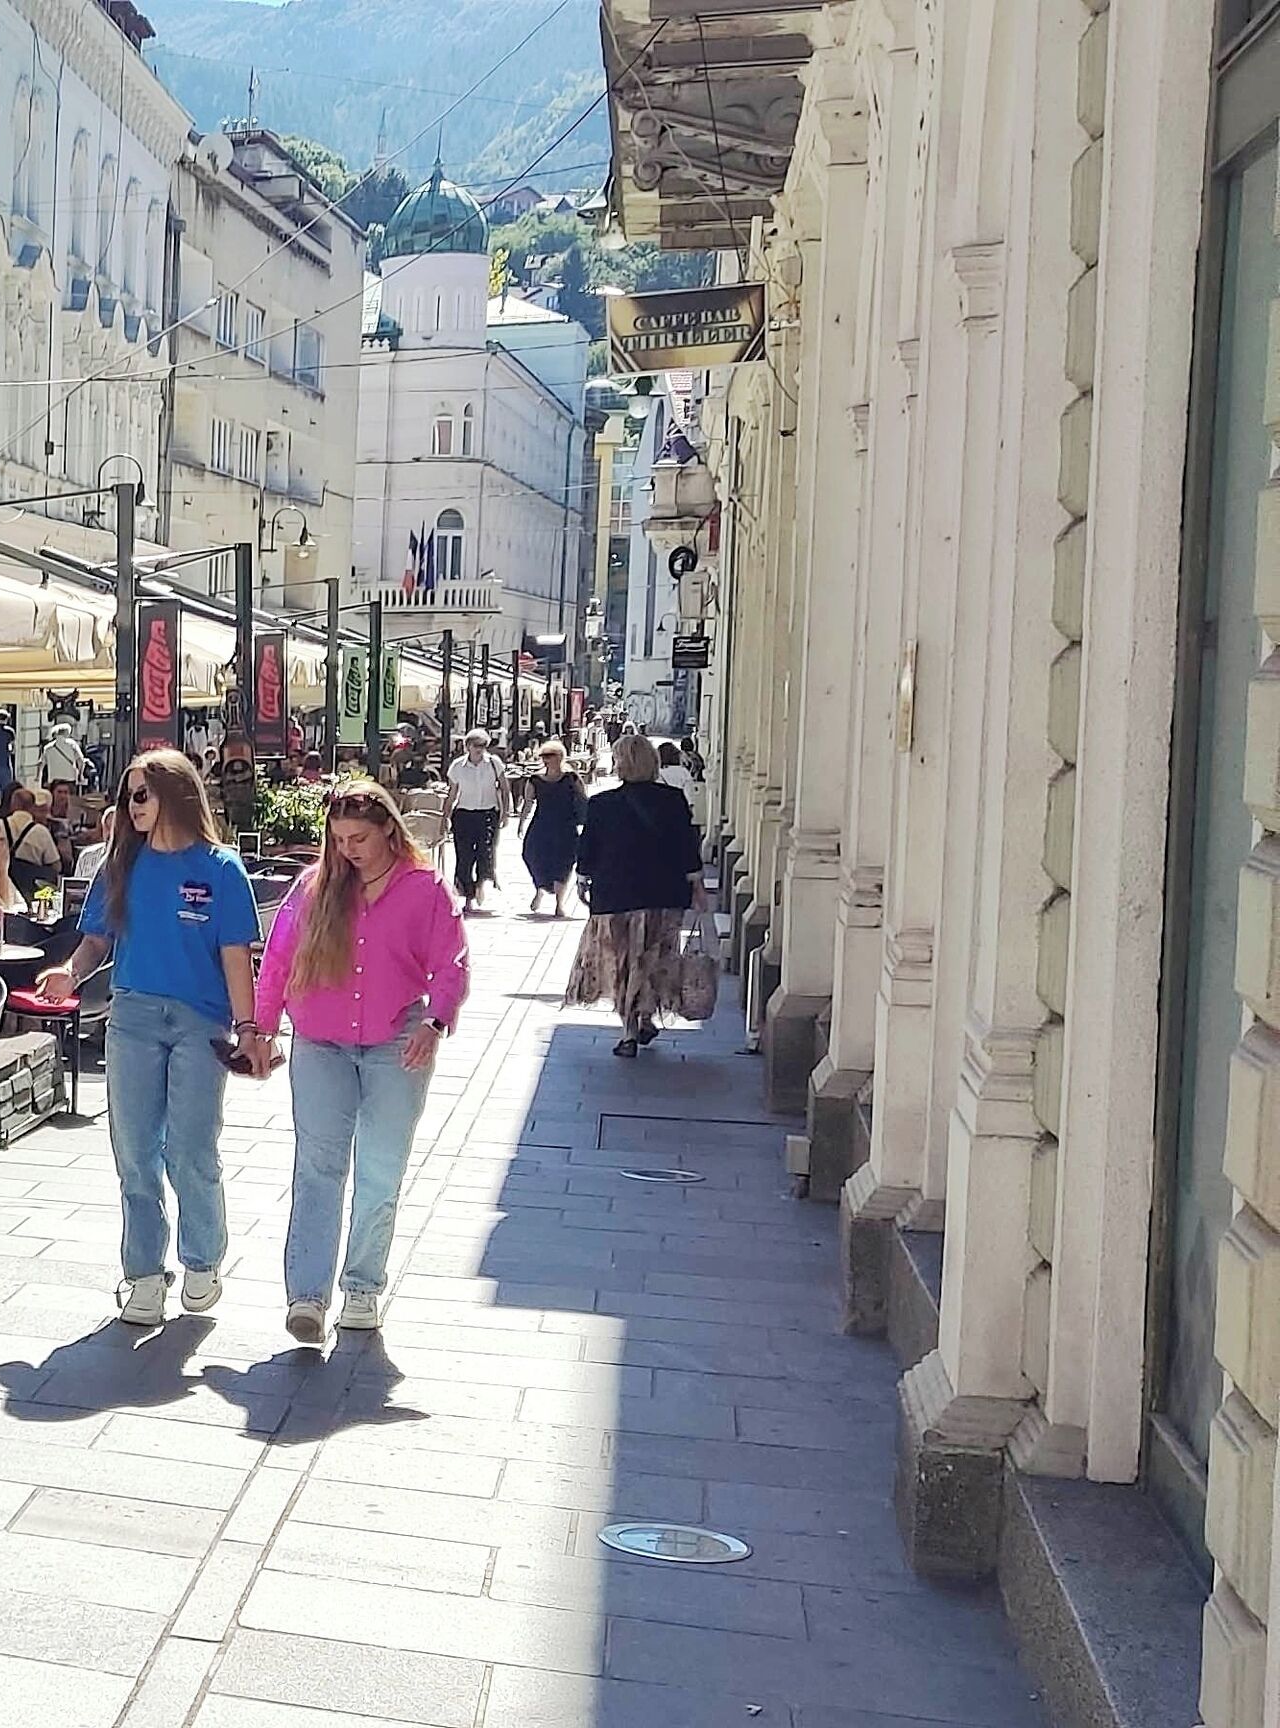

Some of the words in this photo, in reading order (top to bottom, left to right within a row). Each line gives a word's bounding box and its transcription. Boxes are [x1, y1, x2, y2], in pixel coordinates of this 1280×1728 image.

[634, 312, 696, 331] CAFFE
[701, 308, 741, 325] BAR
[622, 325, 752, 353] THRILLER
